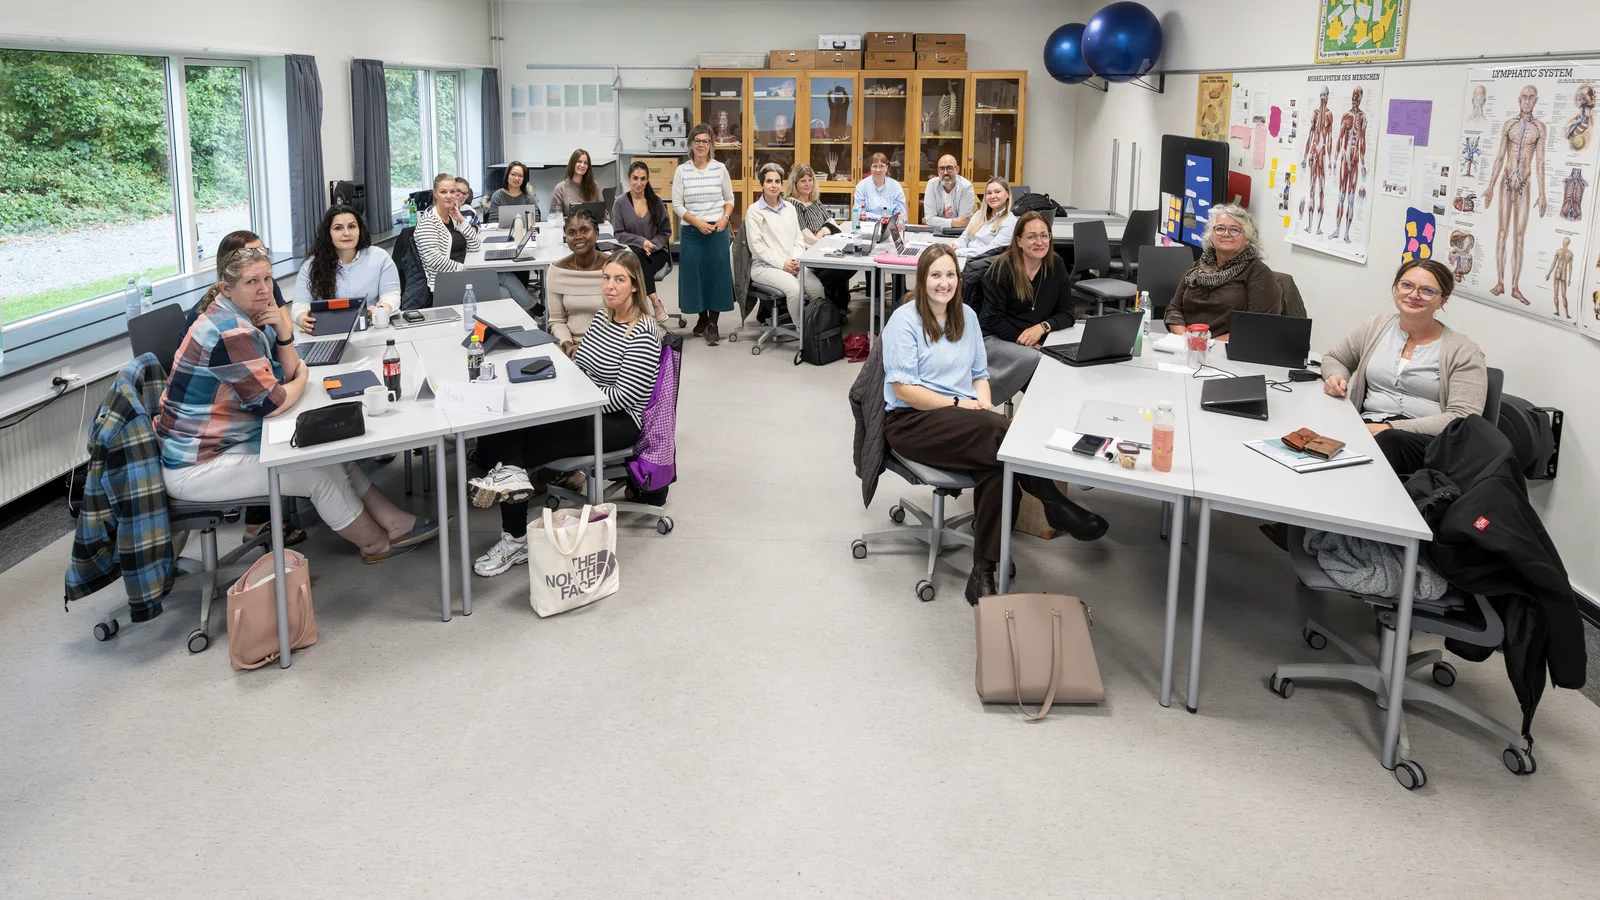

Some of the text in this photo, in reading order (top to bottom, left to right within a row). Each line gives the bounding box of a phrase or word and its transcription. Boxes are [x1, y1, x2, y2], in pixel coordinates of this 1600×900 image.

[1352, 73, 1380, 81] MENSCHEN
[1492, 68, 1573, 79] LYMPHATIC SYSTEM
[572, 553, 596, 570] THE
